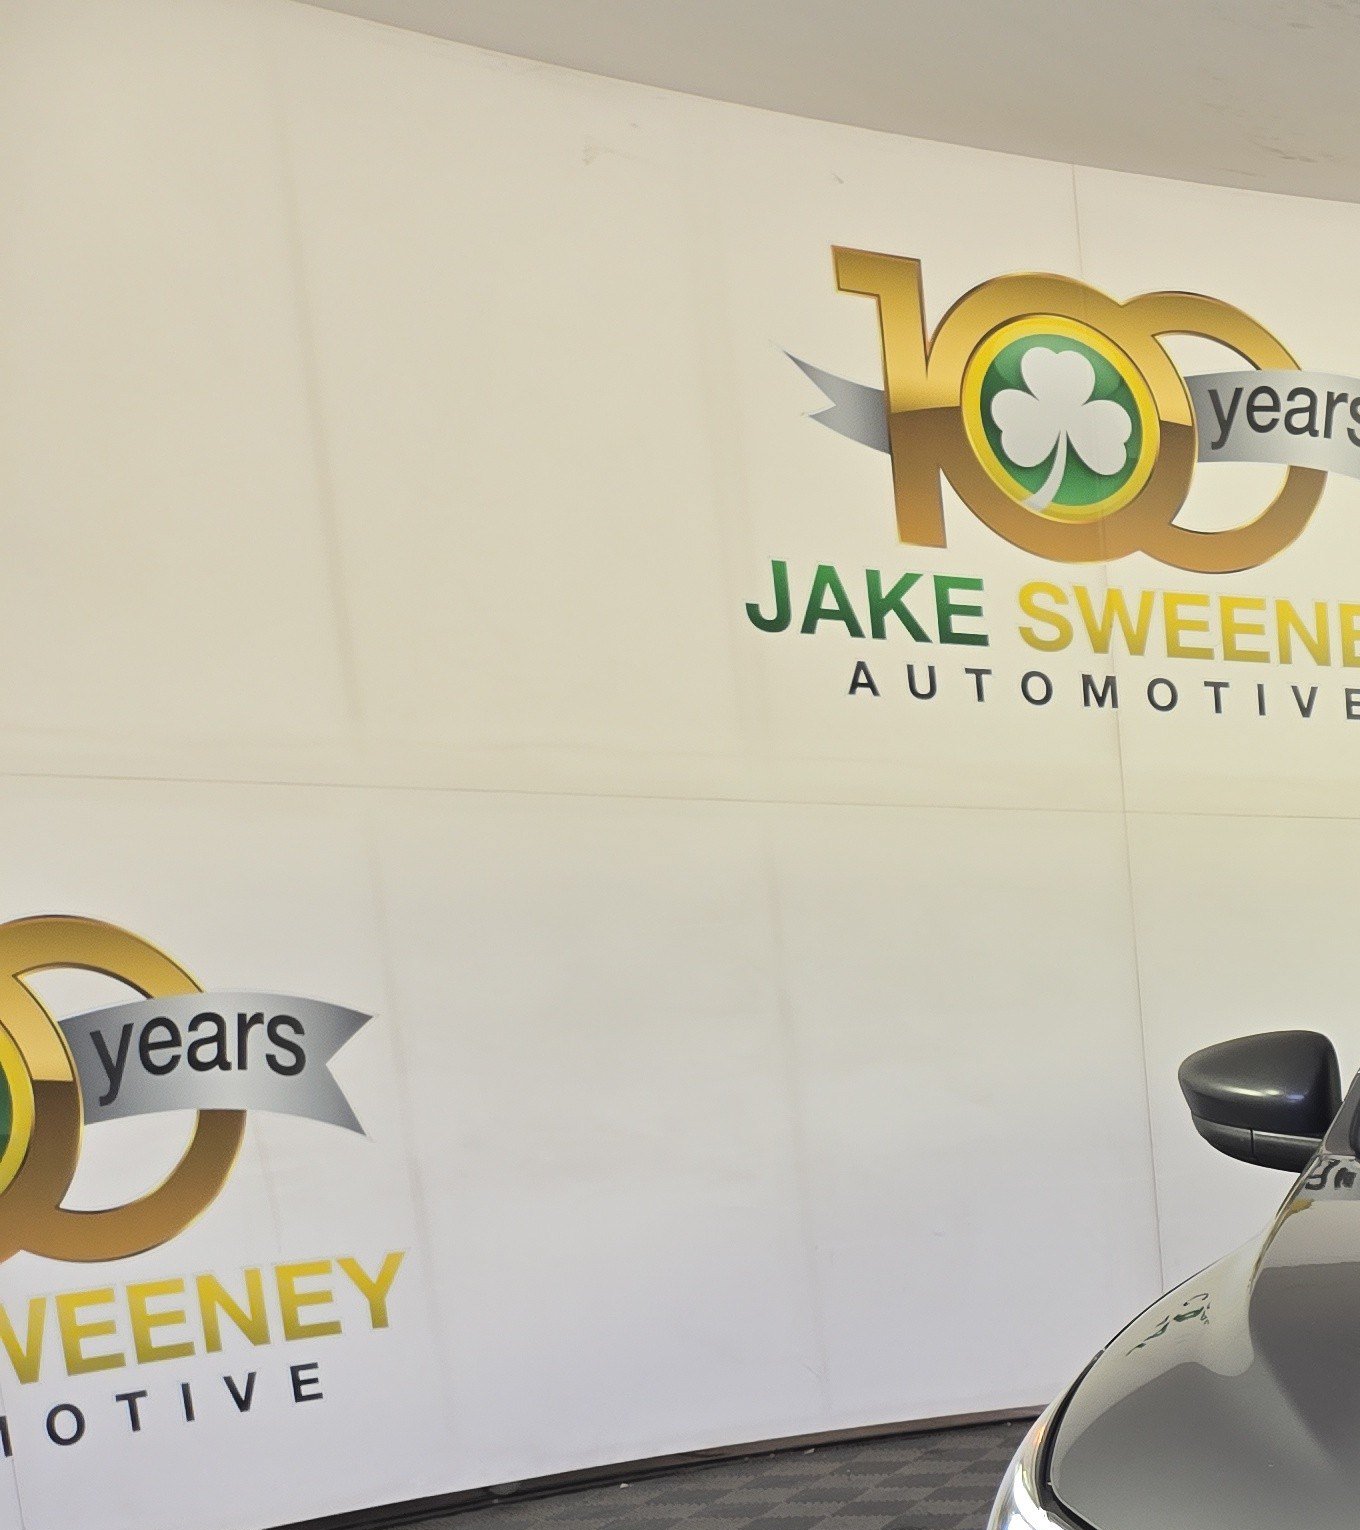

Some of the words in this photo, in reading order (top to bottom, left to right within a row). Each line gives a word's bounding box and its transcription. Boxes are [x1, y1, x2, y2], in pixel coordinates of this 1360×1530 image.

[830, 244, 1328, 574] 100
[745, 558, 990, 647] JAKE
[90, 1010, 307, 1107] years
[0, 1361, 324, 1457] OTIVE
